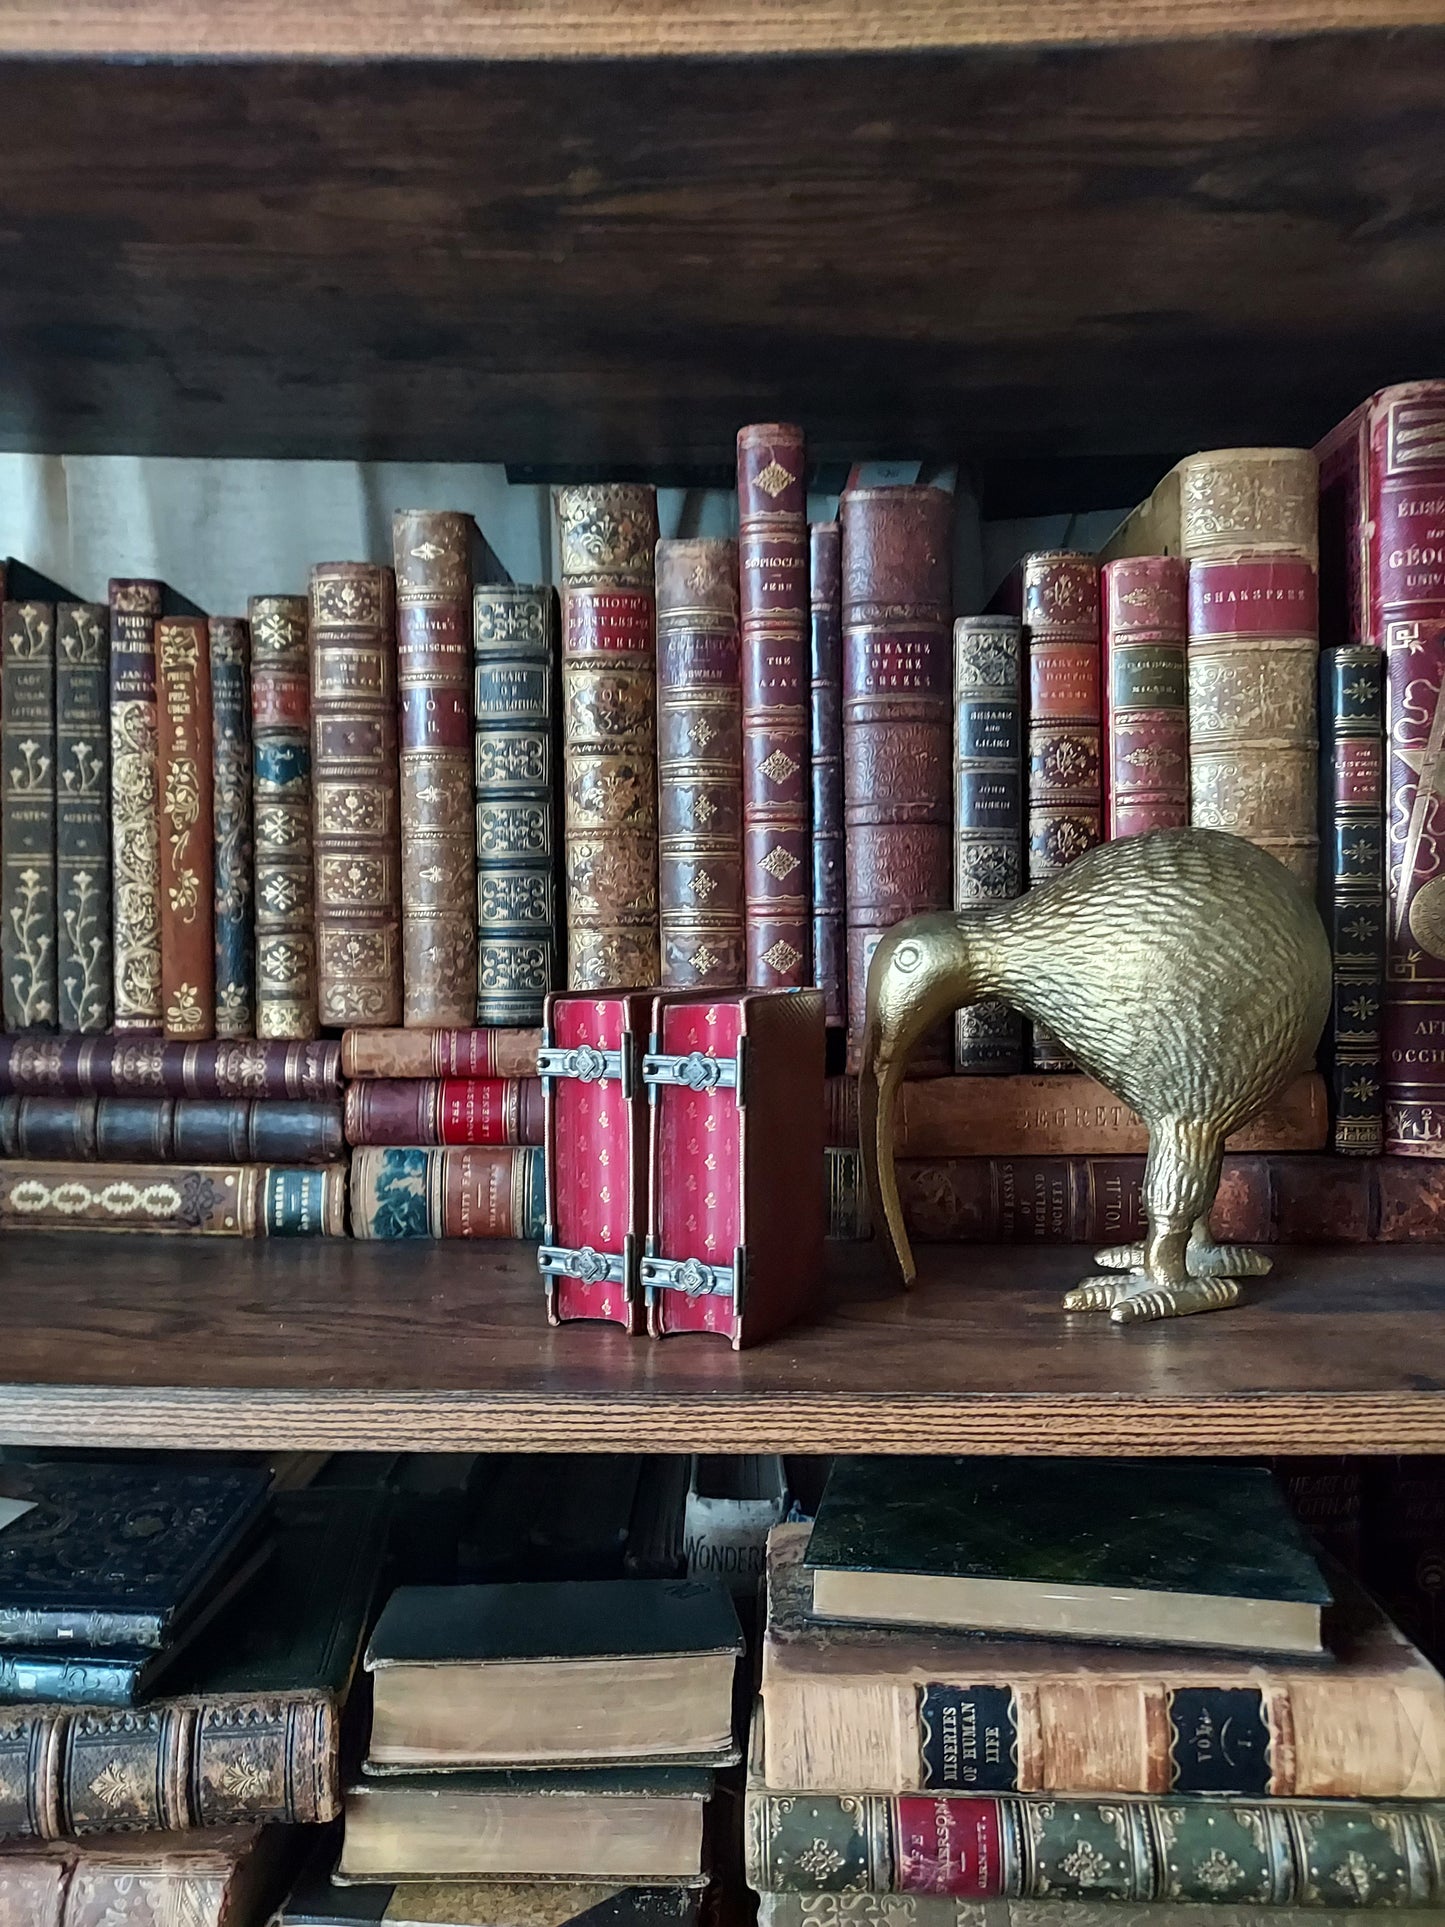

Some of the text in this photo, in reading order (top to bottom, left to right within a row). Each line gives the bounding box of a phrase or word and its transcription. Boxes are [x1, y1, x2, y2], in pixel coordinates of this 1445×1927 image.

[1406, 572, 1445, 587] UNIV
[1203, 588, 1305, 604] SHAKSPERE
[124, 630, 146, 639] AND
[569, 637, 645, 649] GOSPELS
[865, 642, 931, 654] THEATRE
[766, 656, 791, 665] THE
[871, 658, 922, 669] OF THE
[1038, 658, 1073, 669] DIARY
[492, 671, 528, 683] HEART
[759, 678, 799, 688] AJAX
[501, 685, 518, 696] OF
[403, 700, 465, 713] VOL.
[427, 721, 440, 733] II.
[452, 1100, 460, 1125] THE
[1034, 1173, 1046, 1236] HIGHLAND
[1052, 1179, 1063, 1233] SOCIETY
[943, 1706, 958, 1782] MISERIES
[961, 1702, 978, 1782] OF HUMAN
[985, 1726, 1000, 1764] LIFE
